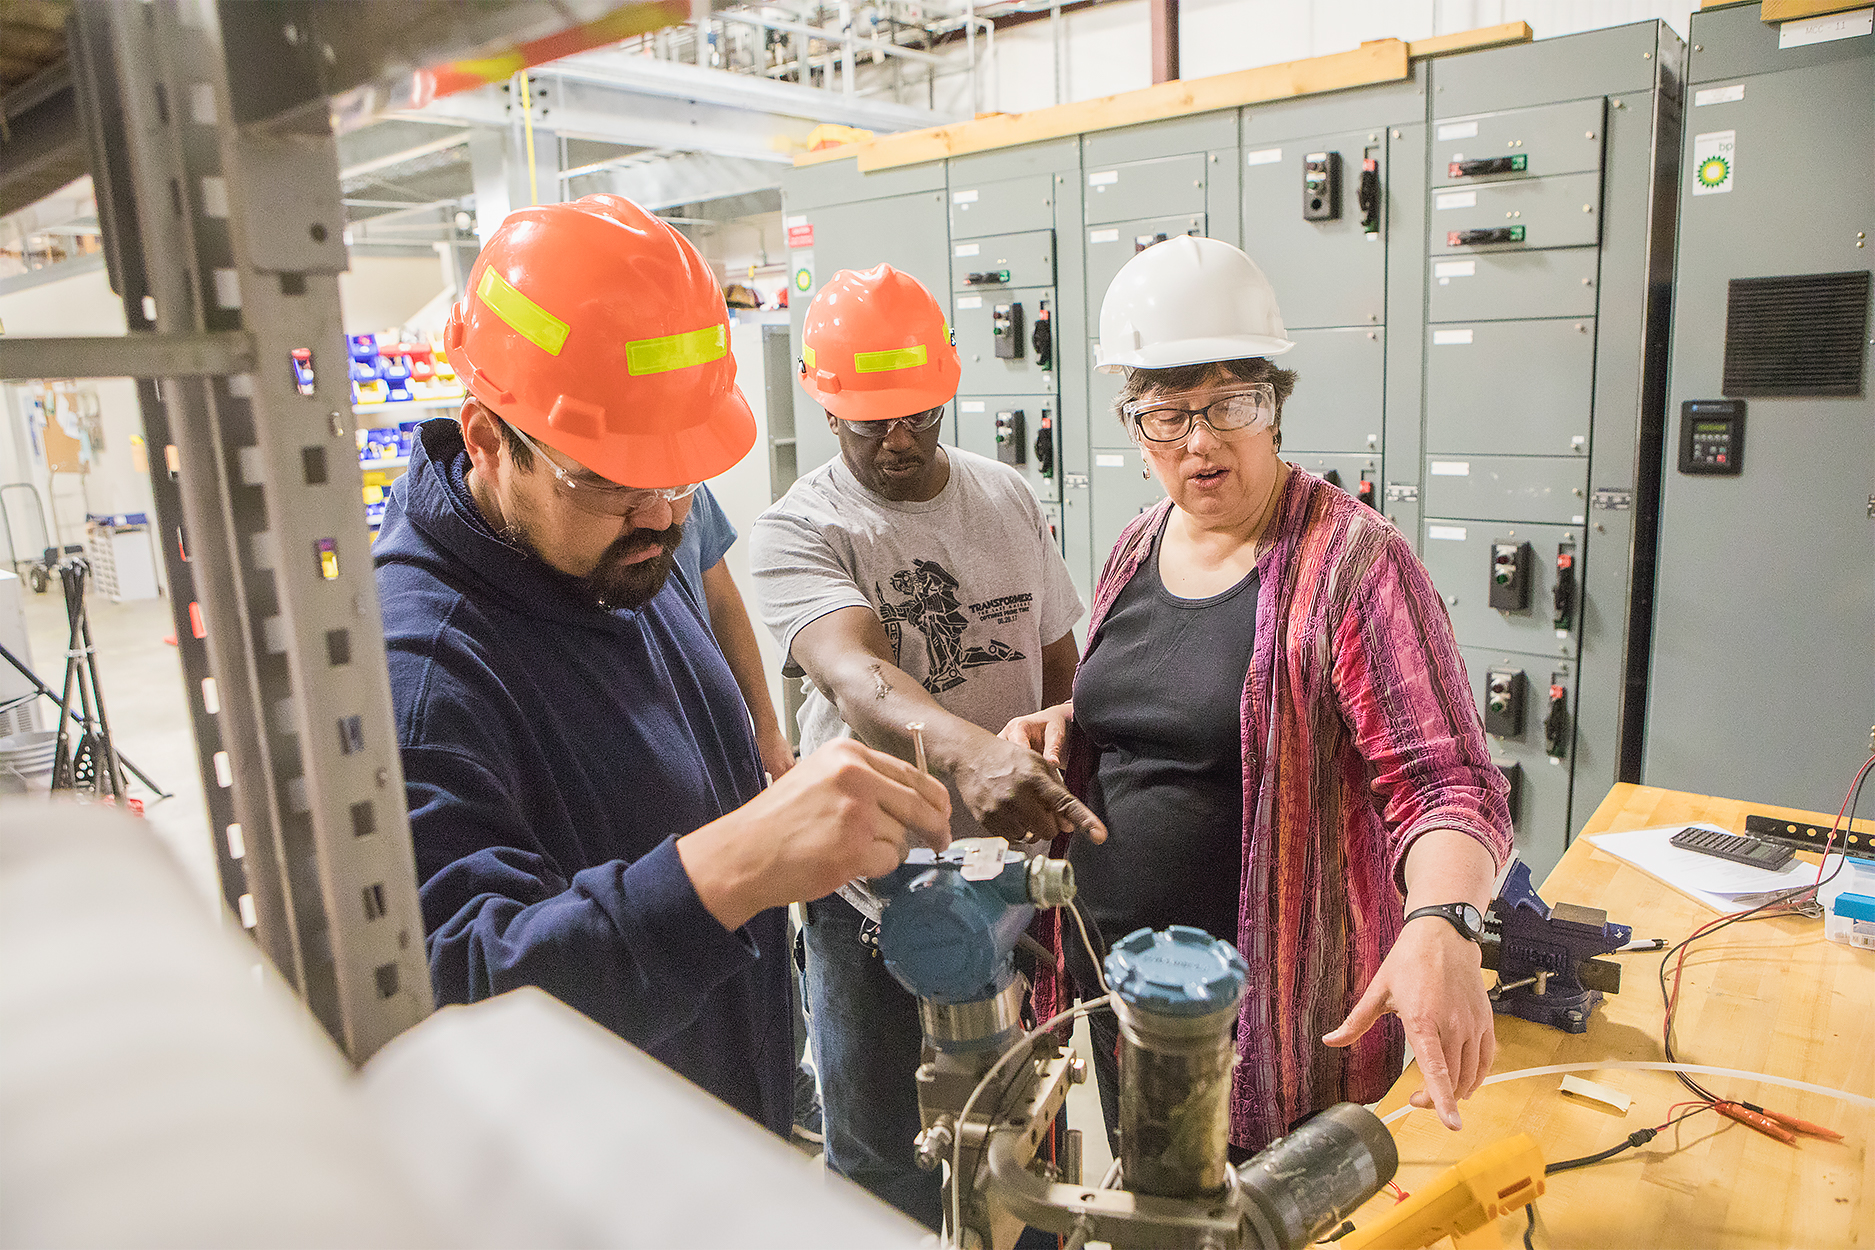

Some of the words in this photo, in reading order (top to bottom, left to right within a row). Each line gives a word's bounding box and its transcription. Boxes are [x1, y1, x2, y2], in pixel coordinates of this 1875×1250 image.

[1805, 24, 1824, 35] MCC
[1835, 21, 1846, 31] 11
[1719, 142, 1734, 153] bp
[968, 592, 1033, 613] TRANSFORMERS
[979, 611, 1003, 621] OPTIMUS
